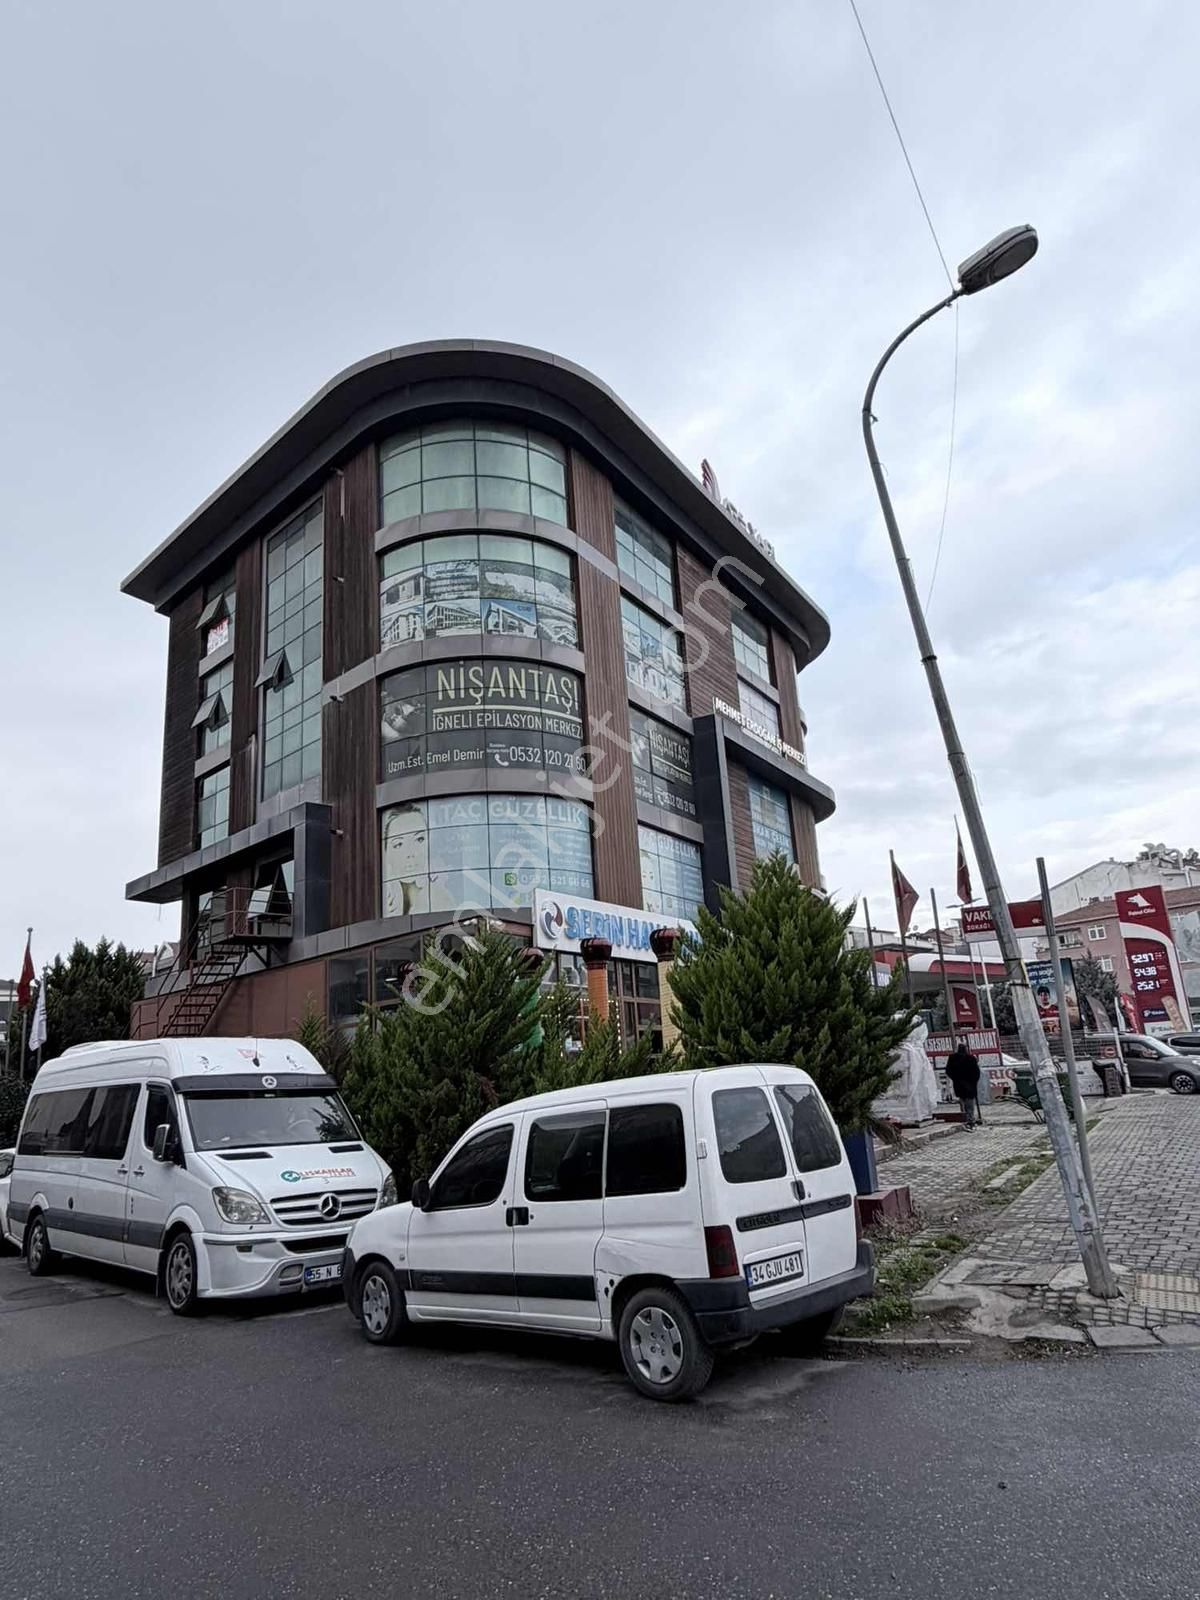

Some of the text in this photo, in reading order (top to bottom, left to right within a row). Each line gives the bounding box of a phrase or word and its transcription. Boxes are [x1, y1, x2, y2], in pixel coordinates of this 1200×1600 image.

[437, 661, 579, 714] NİŞANTAŞI
[432, 713, 472, 731] İĞNELİ
[476, 710, 542, 729] EPİLASYON
[715, 697, 746, 726] MEHMET
[426, 751, 451, 765] Emel
[453, 748, 485, 761] Demir
[509, 746, 541, 763] 0532
[544, 749, 562, 766] 120
[752, 1256, 800, 1282] 34 GJU 481
